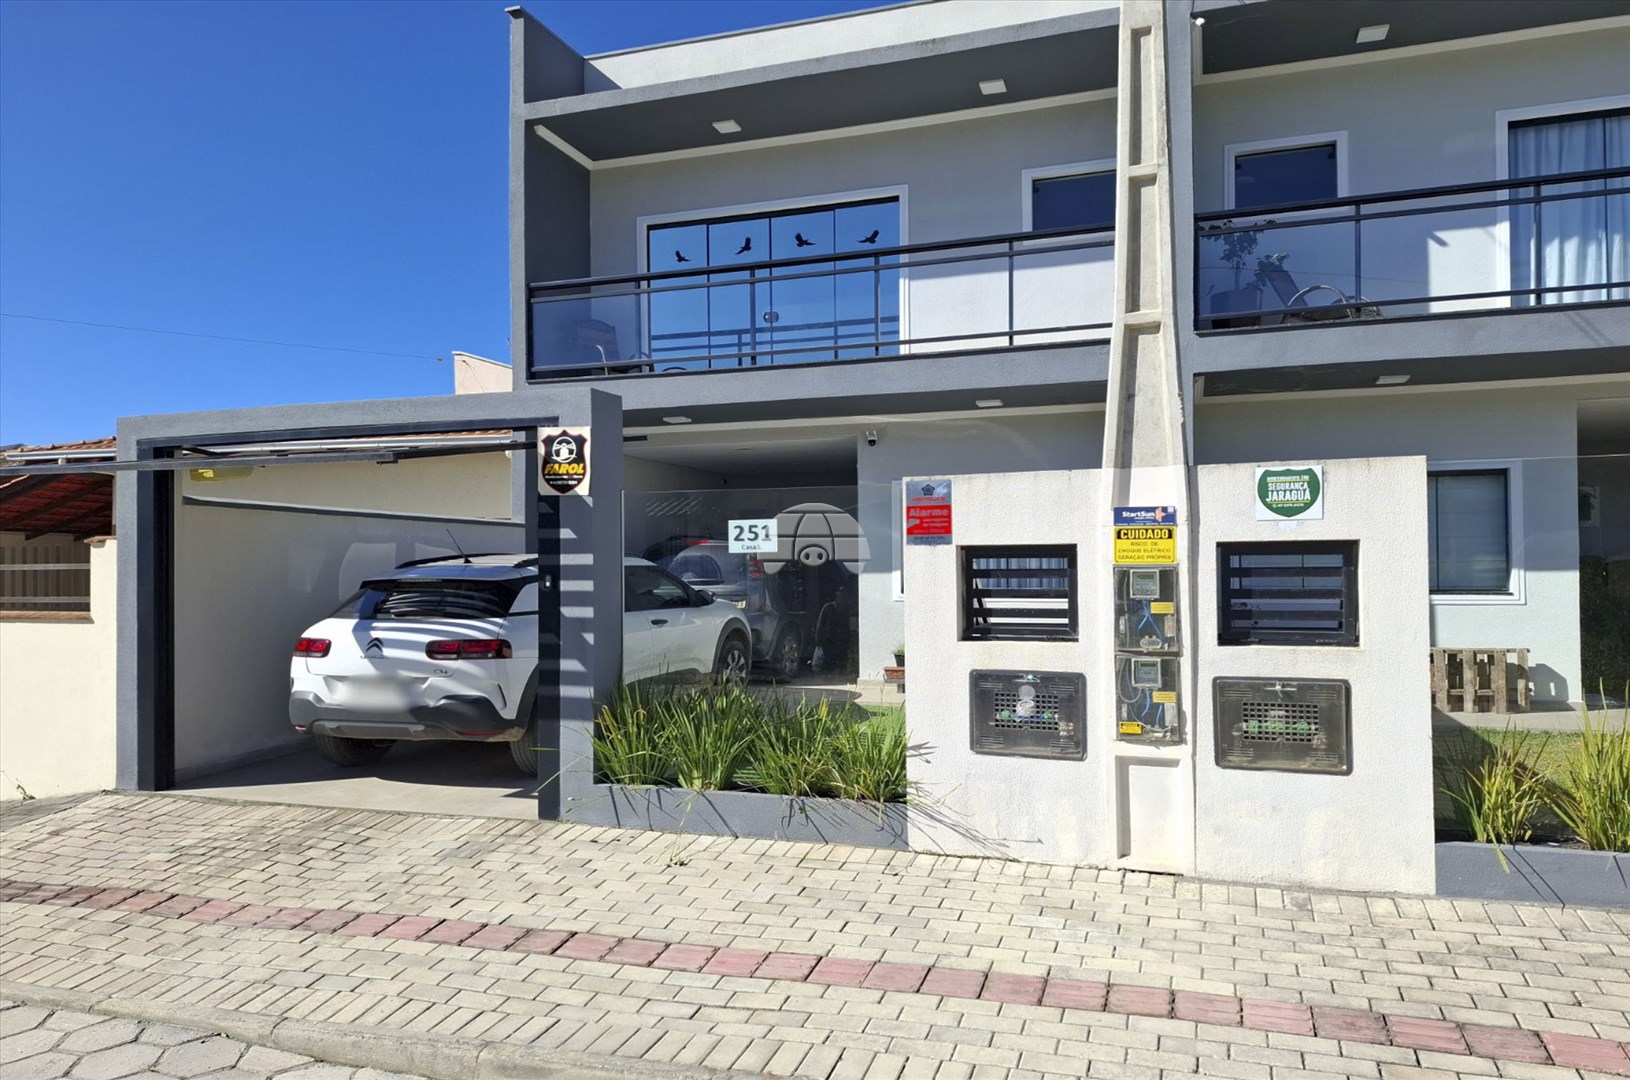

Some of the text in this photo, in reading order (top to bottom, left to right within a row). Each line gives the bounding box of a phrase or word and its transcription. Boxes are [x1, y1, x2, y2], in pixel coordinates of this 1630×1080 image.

[544, 463, 585, 474] FAROL
[1267, 481, 1309, 491] SEGURANÇA
[1265, 488, 1311, 502] JARAGUÁ
[908, 508, 949, 517] Alarme
[1122, 510, 1155, 518] StartSun
[733, 524, 772, 541] 251
[1120, 528, 1169, 539] CUIDADO
